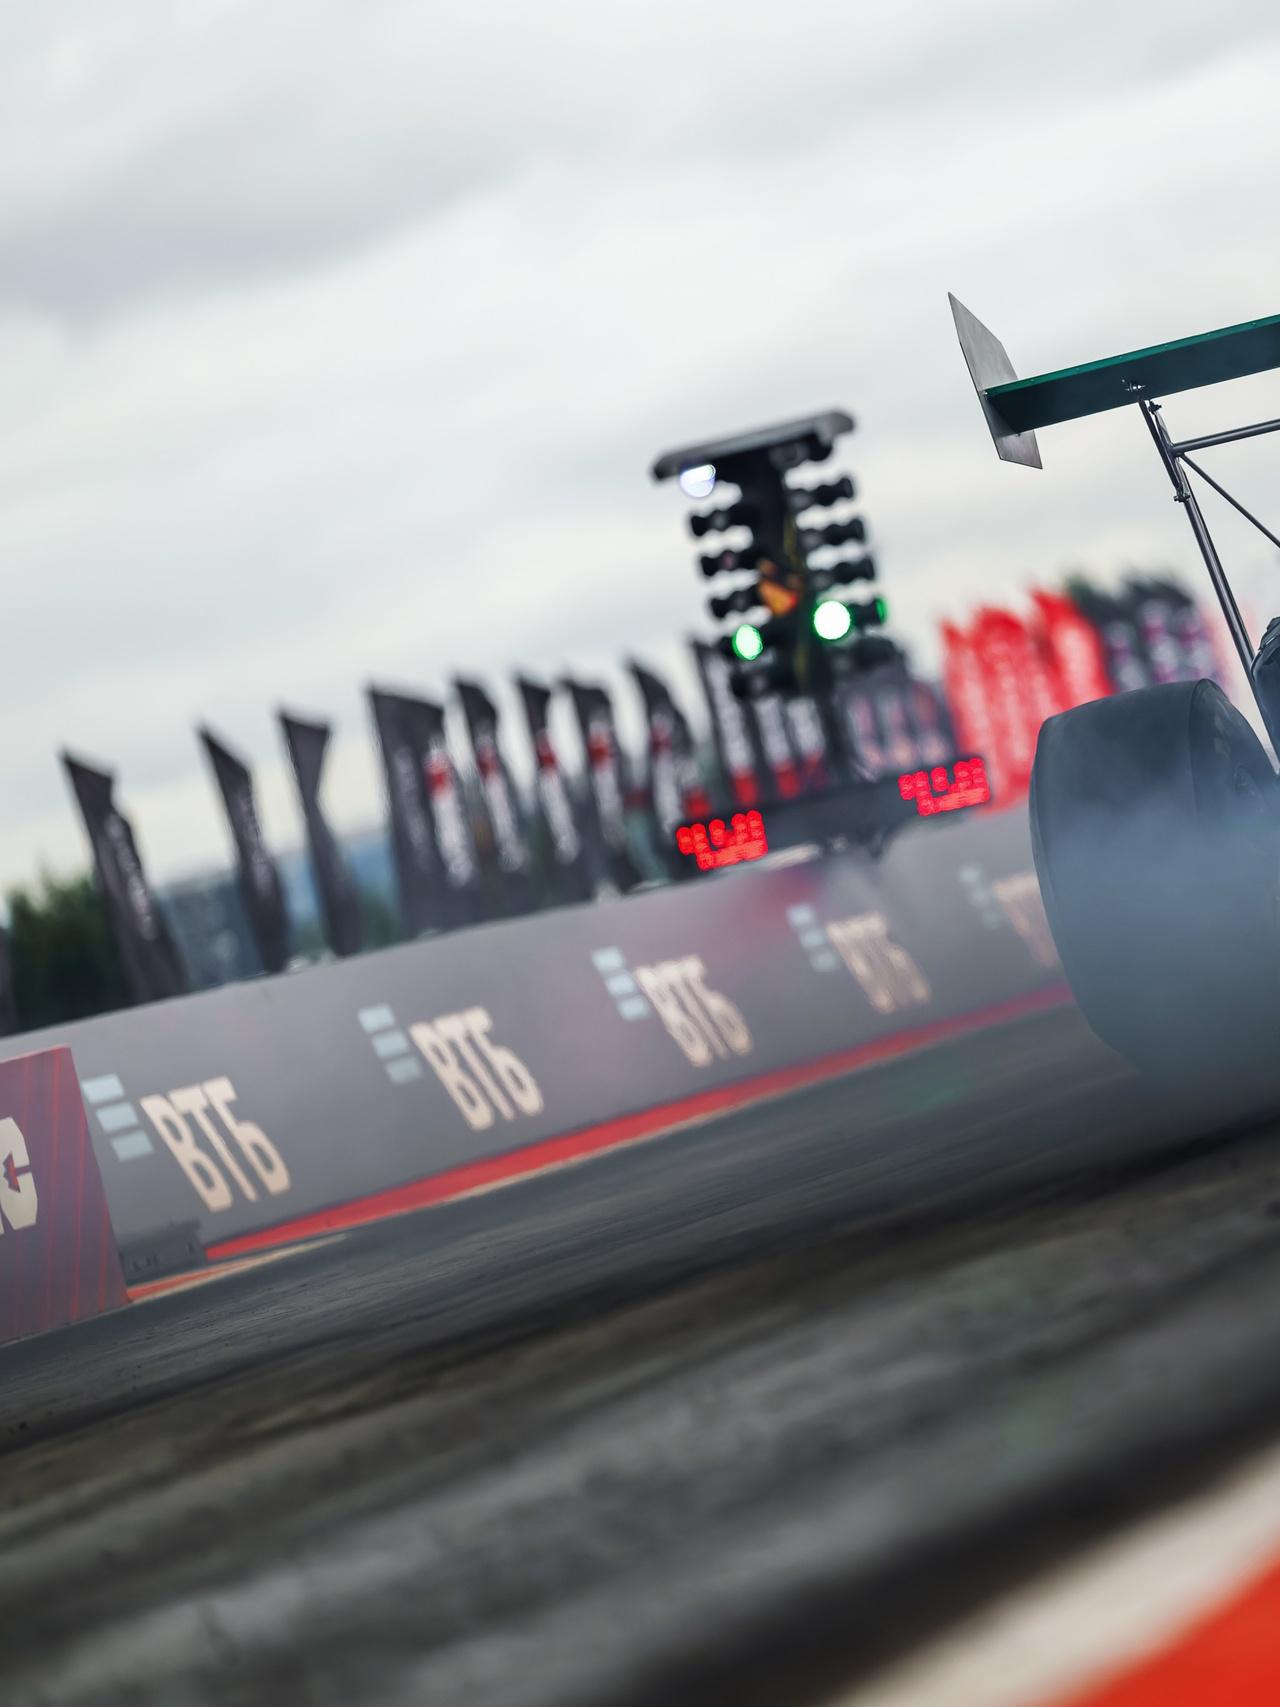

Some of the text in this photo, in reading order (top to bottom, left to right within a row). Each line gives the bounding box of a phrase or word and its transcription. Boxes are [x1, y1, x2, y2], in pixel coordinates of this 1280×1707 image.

[409, 1006, 543, 1130] ВТБ
[635, 955, 753, 1066] ВТБ
[141, 1076, 290, 1212] ВТБ
